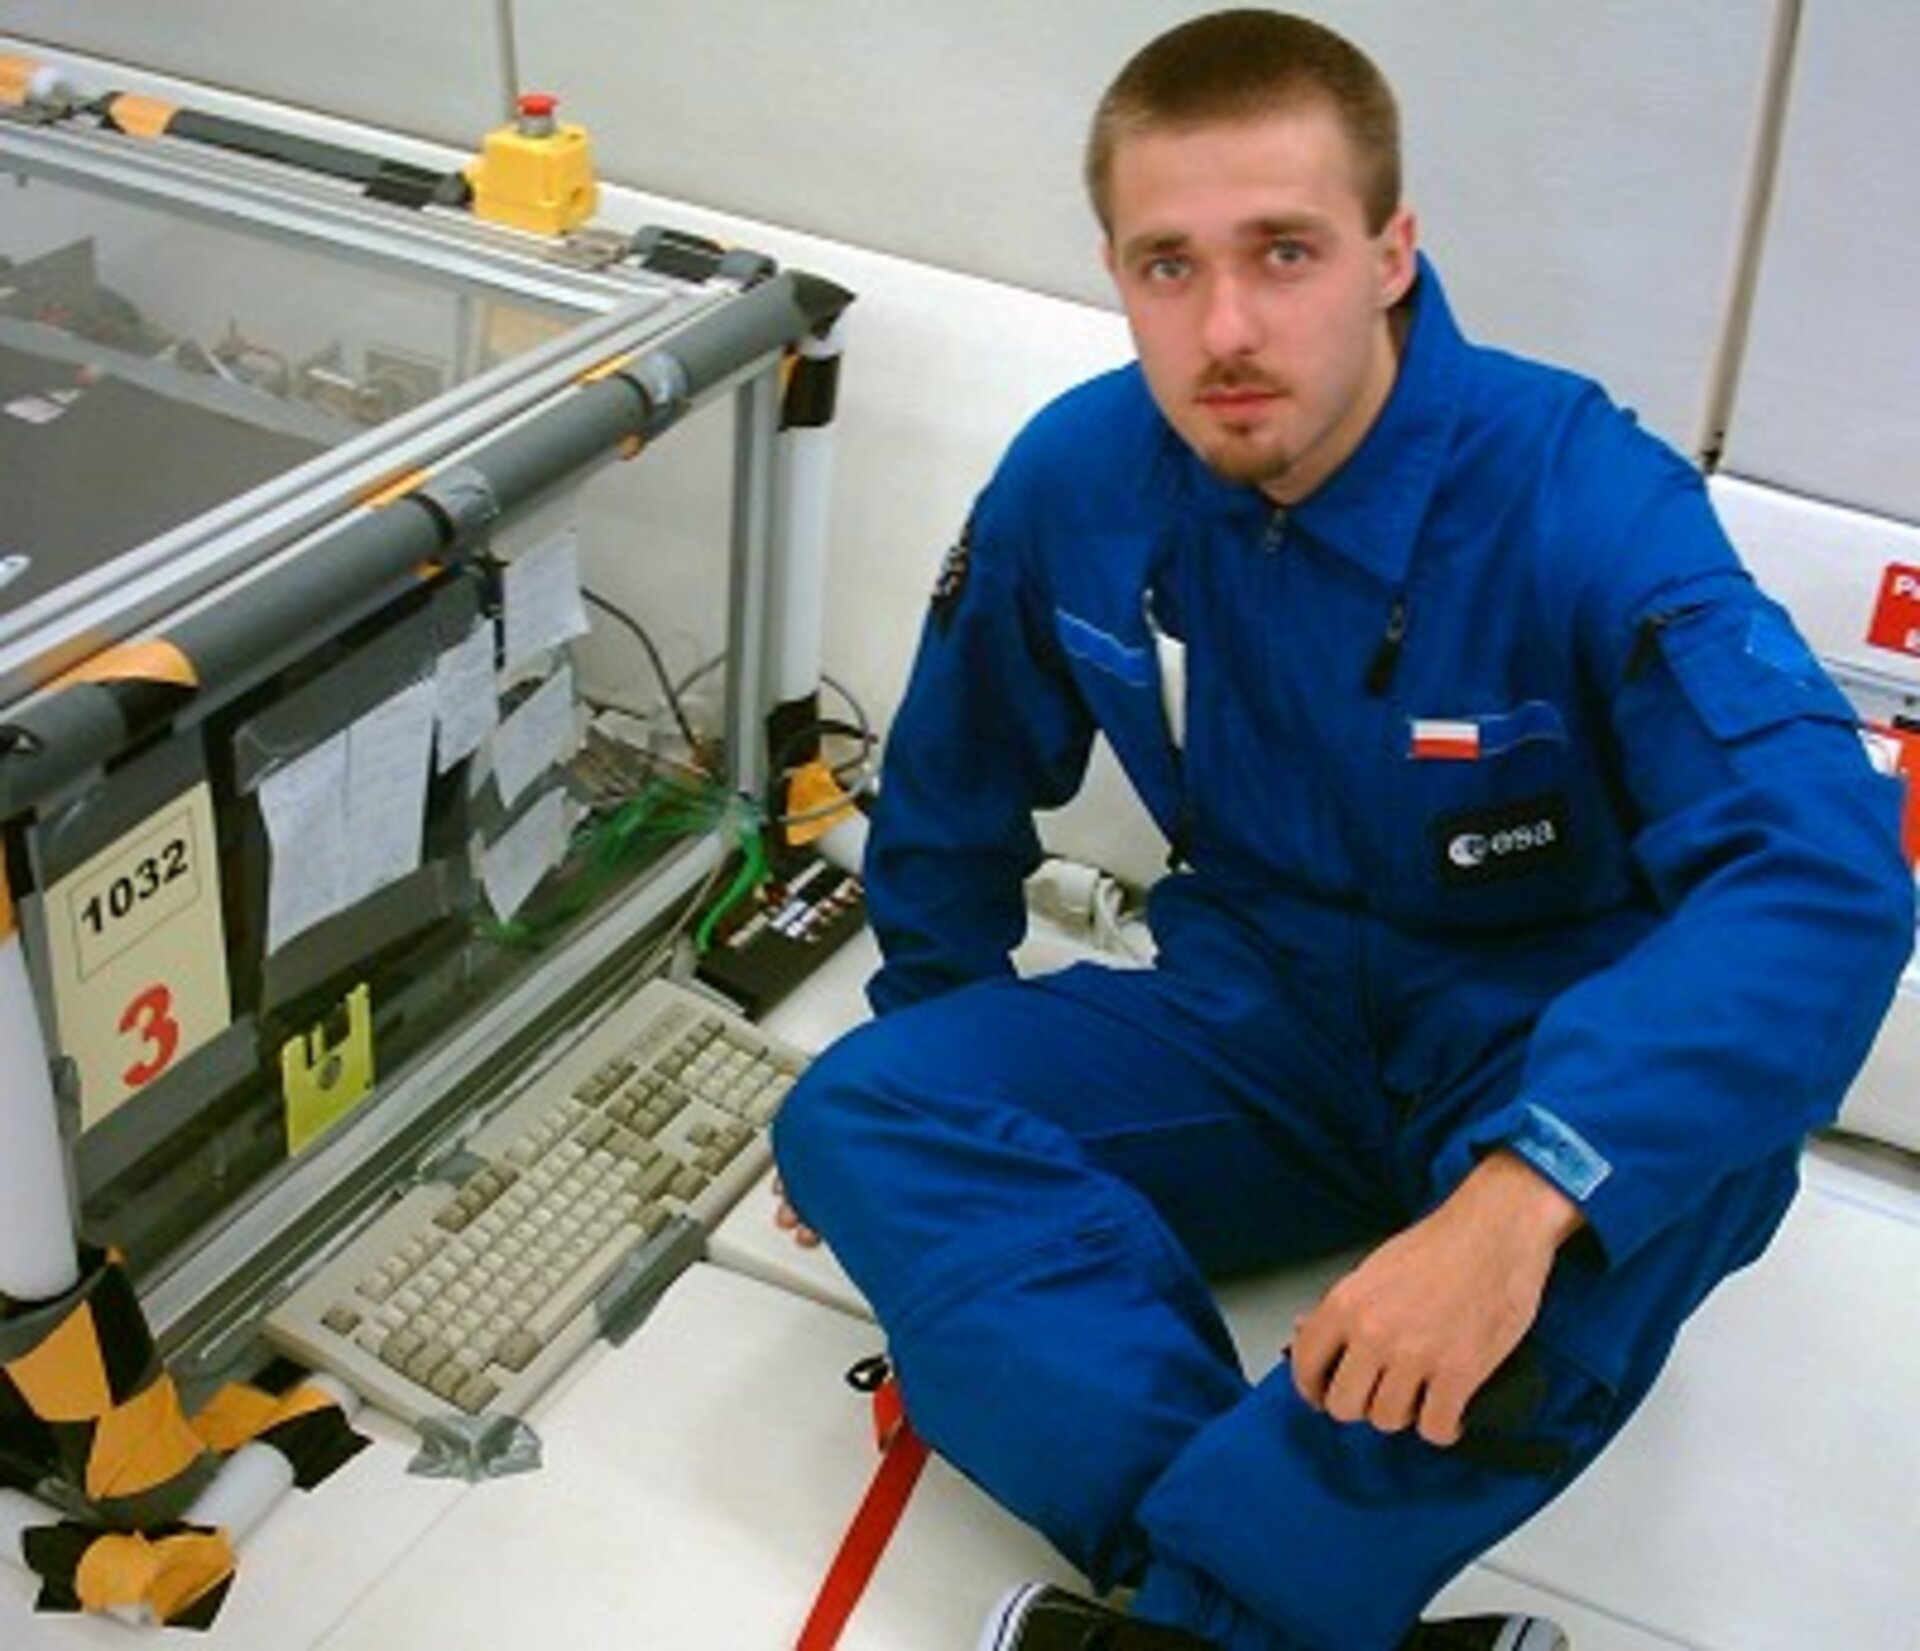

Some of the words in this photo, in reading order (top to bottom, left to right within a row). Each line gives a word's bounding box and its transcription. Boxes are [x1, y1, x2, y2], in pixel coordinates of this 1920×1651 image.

[1491, 819, 1556, 854] esa
[80, 838, 190, 933] 1032
[117, 984, 180, 1087] 3
